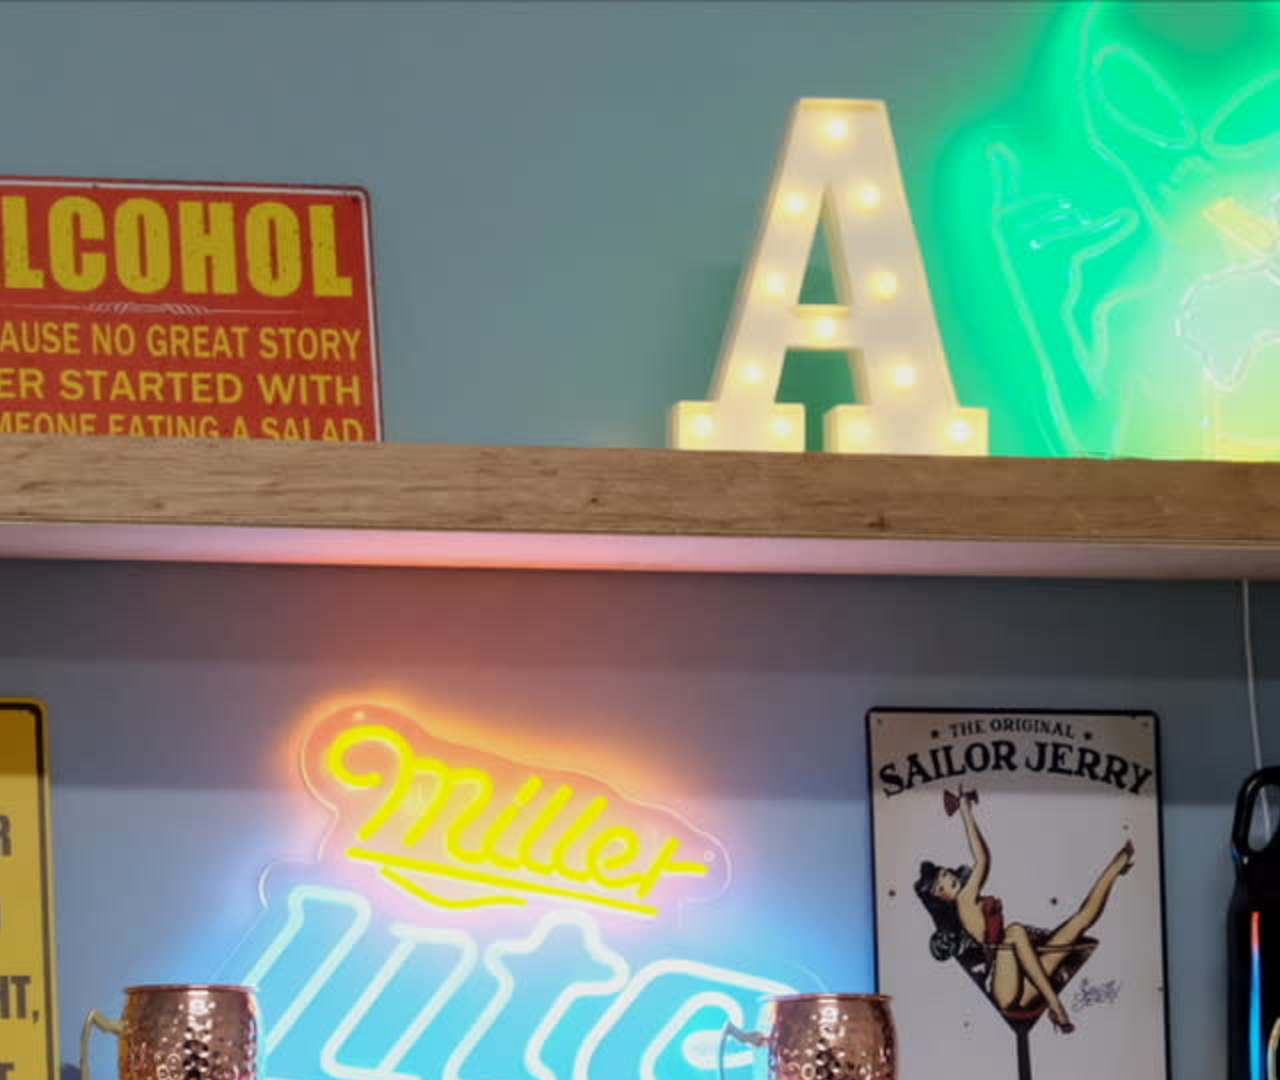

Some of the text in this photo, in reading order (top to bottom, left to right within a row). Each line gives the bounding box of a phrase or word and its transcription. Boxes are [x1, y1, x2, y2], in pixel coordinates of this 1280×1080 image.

[92, 322, 136, 357] NO
[147, 325, 249, 359] GREAT
[259, 327, 362, 360] STORY
[60, 369, 244, 403] STARTED
[257, 373, 361, 407] WITH
[949, 718, 1075, 740] THE ORIGINAL
[878, 739, 1153, 797] SAILOR JERRY
[326, 723, 710, 899] Miller
